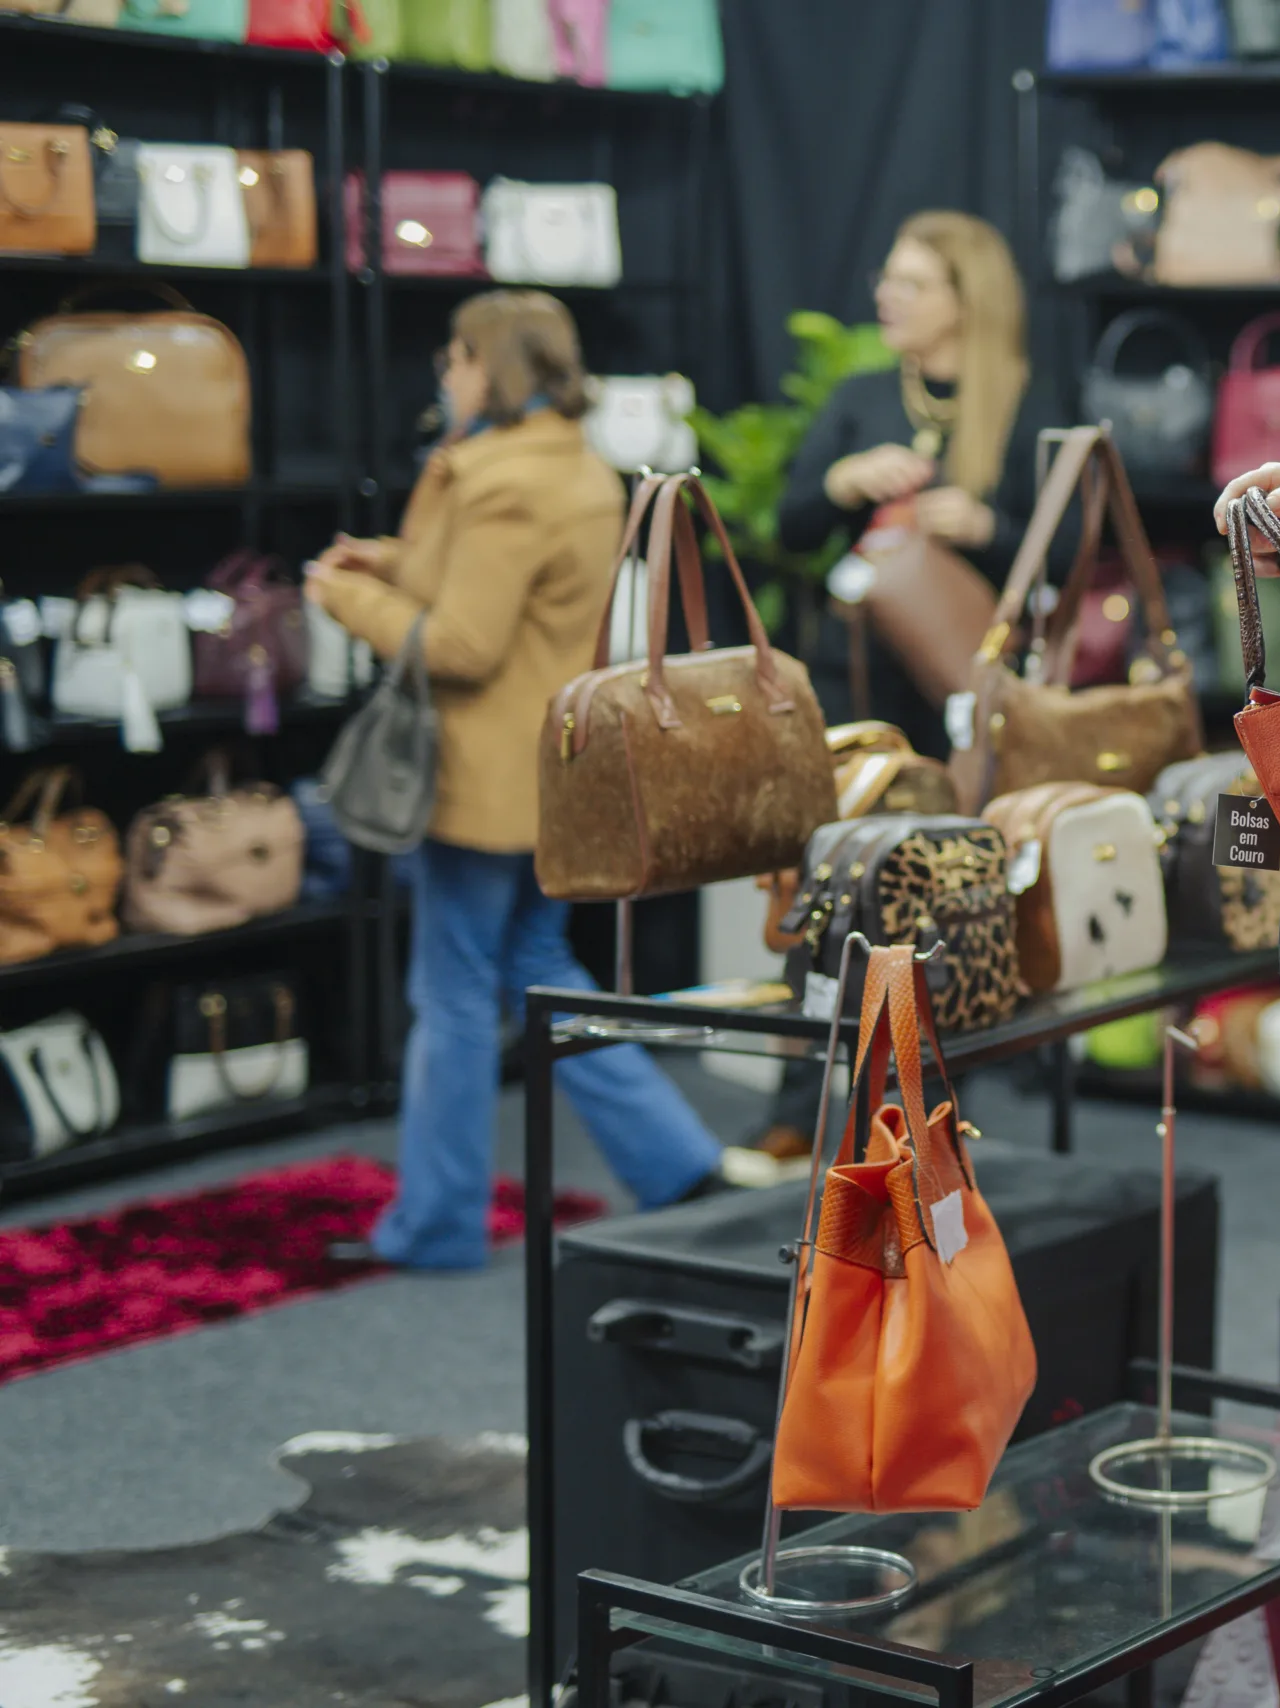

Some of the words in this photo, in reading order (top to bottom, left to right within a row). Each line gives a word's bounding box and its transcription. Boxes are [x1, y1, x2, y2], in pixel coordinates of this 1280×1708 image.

[1230, 810, 1270, 830] Bolsas
[1239, 832, 1258, 846] em
[1229, 845, 1265, 864] Couro
